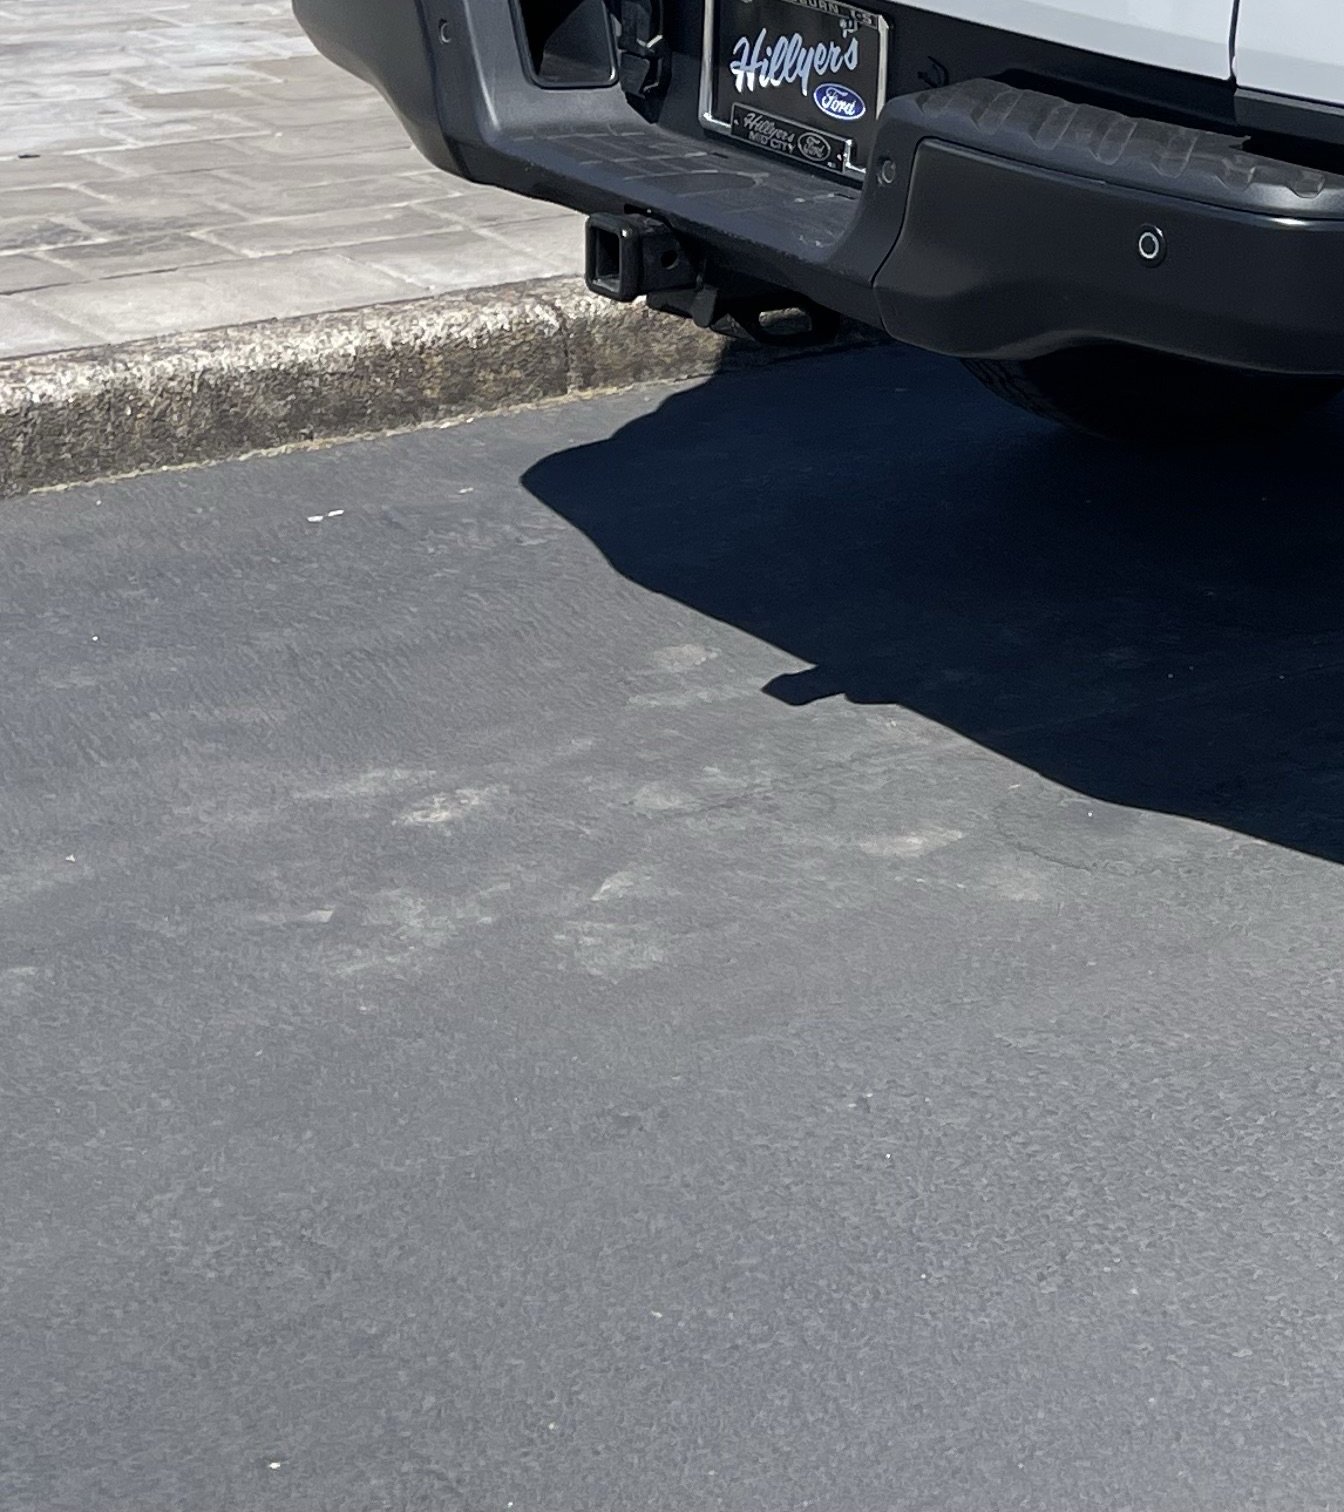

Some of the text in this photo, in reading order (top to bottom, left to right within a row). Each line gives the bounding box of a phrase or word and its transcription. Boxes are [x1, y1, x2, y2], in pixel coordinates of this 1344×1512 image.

[730, 27, 859, 97] Hillyer's
[821, 87, 856, 116] Ford
[769, 139, 796, 154] CITY
